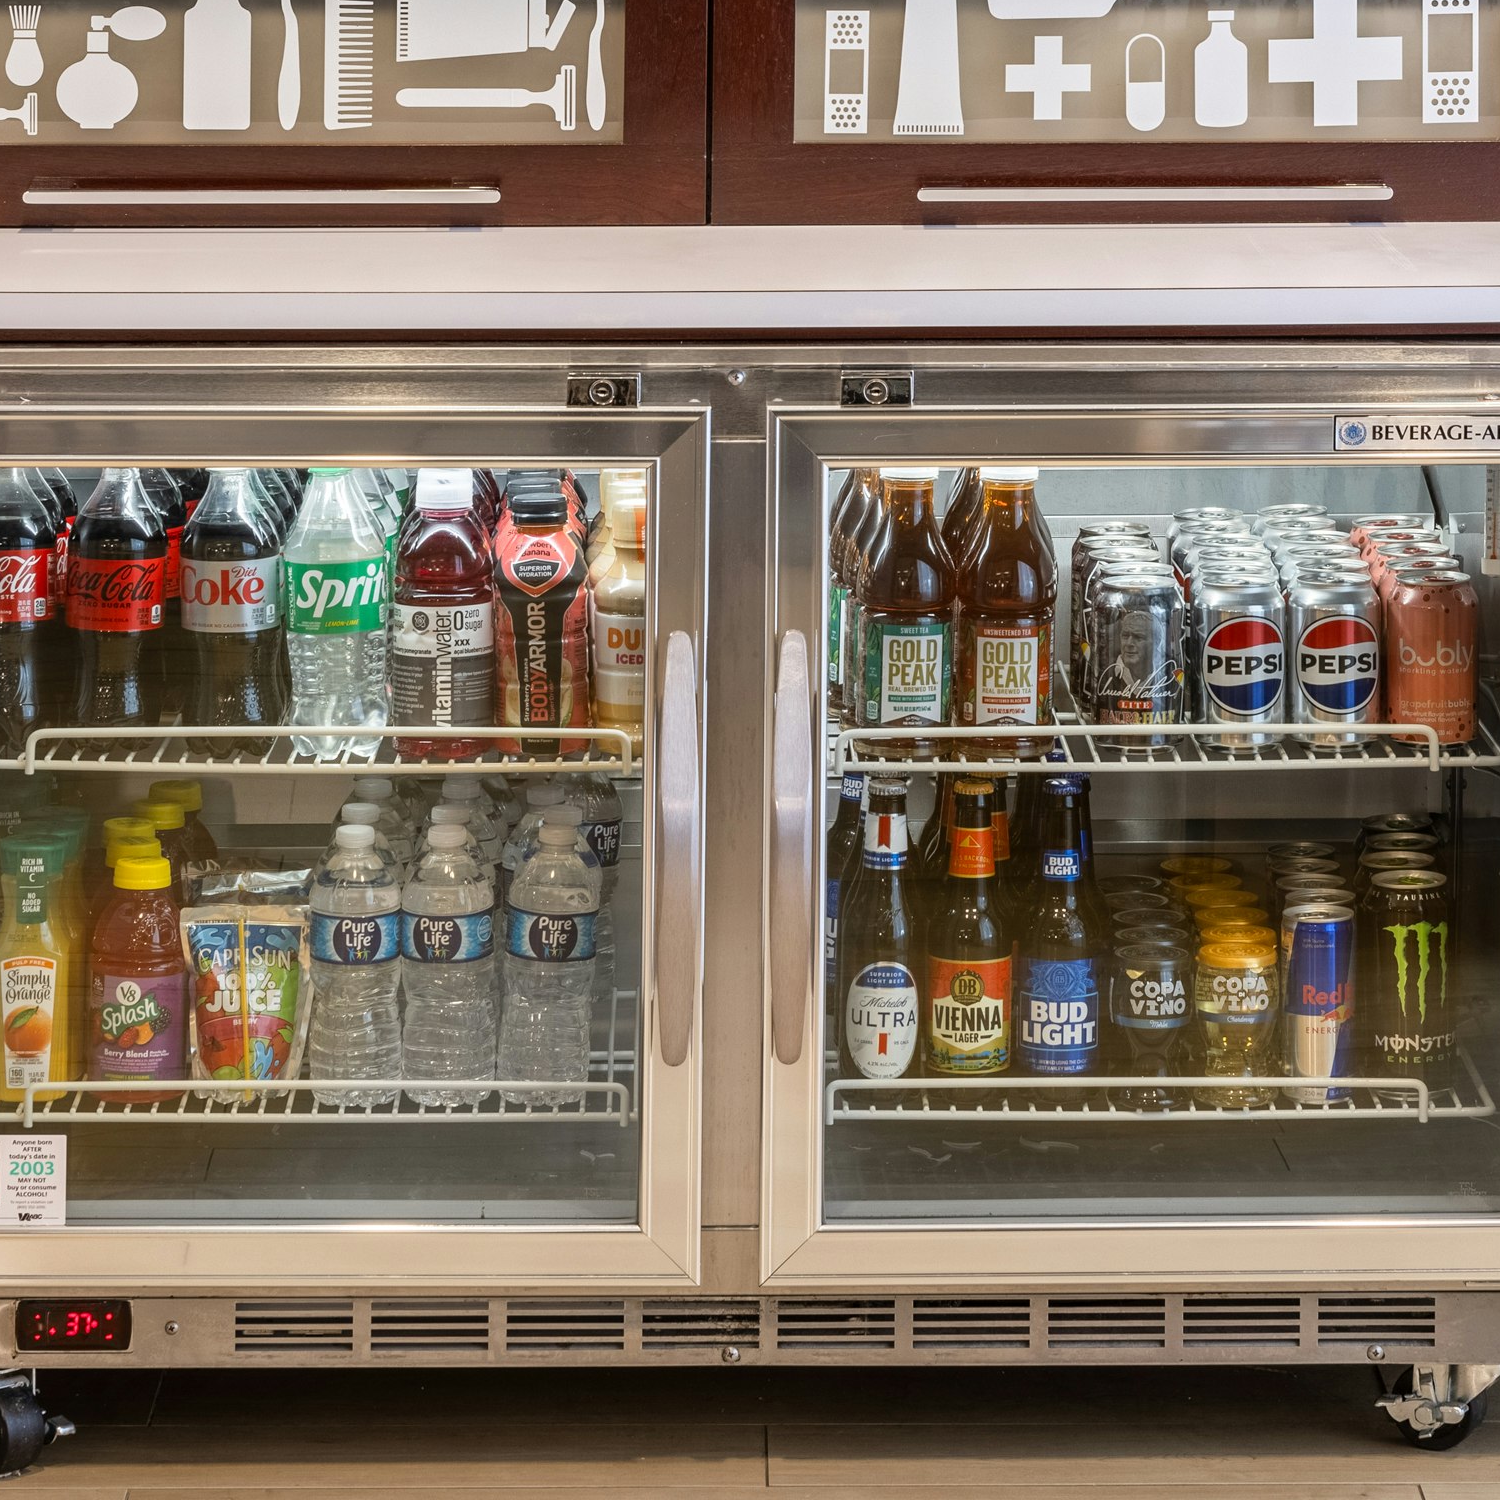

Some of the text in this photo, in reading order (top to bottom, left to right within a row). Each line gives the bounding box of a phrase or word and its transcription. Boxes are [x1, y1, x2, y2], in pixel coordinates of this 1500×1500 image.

[231, 566, 258, 578] Diet
[180, 565, 265, 606] Coke
[464, 609, 479, 618] zero
[888, 639, 938, 663] GOLD
[982, 641, 1032, 664] GOLD
[1399, 637, 1474, 673] bubly
[432, 610, 452, 727] vitaminwater
[527, 601, 549, 722] BODYARMOR
[1207, 653, 1283, 675] PEPSI
[1301, 652, 1377, 674] PEPSI
[888, 662, 938, 686] PEAK
[982, 665, 1032, 688] PEAK
[1121, 701, 1151, 709] LITE
[594, 824, 620, 838] Pure
[597, 836, 617, 852] Life
[20, 865, 45, 874] VITAMIN
[1048, 857, 1073, 866] BUD
[29, 873, 36, 882] C
[22, 898, 42, 906] ADDED
[22, 905, 41, 913] SUGAR
[341, 919, 375, 933] Pure
[419, 917, 454, 932] Pure
[538, 916, 573, 931] Pure
[345, 933, 373, 949] Life
[423, 931, 451, 947] Life
[541, 930, 568, 946] Life
[251, 945, 292, 971] SUN
[6, 969, 51, 989] Simply
[1212, 975, 1268, 993] COPA
[5, 986, 51, 1004] Orange
[1130, 980, 1185, 998] COPA
[1302, 984, 1342, 1005] Red
[205, 989, 282, 1012] JUCE
[859, 995, 908, 1008] Michelob
[1130, 998, 1186, 1015] VINO
[1212, 994, 1269, 1012] VINO
[101, 999, 159, 1036] Splash
[851, 1010, 917, 1027] ULTRA
[934, 1004, 1001, 1032] VIENNA
[1030, 1001, 1089, 1023] BUD
[954, 1033, 979, 1044] LAGER
[1022, 1019, 1096, 1045] LIGHT
[104, 1049, 124, 1058] Berry
[9, 1161, 55, 1176] 2003
[66, 1312, 91, 1336] 37
